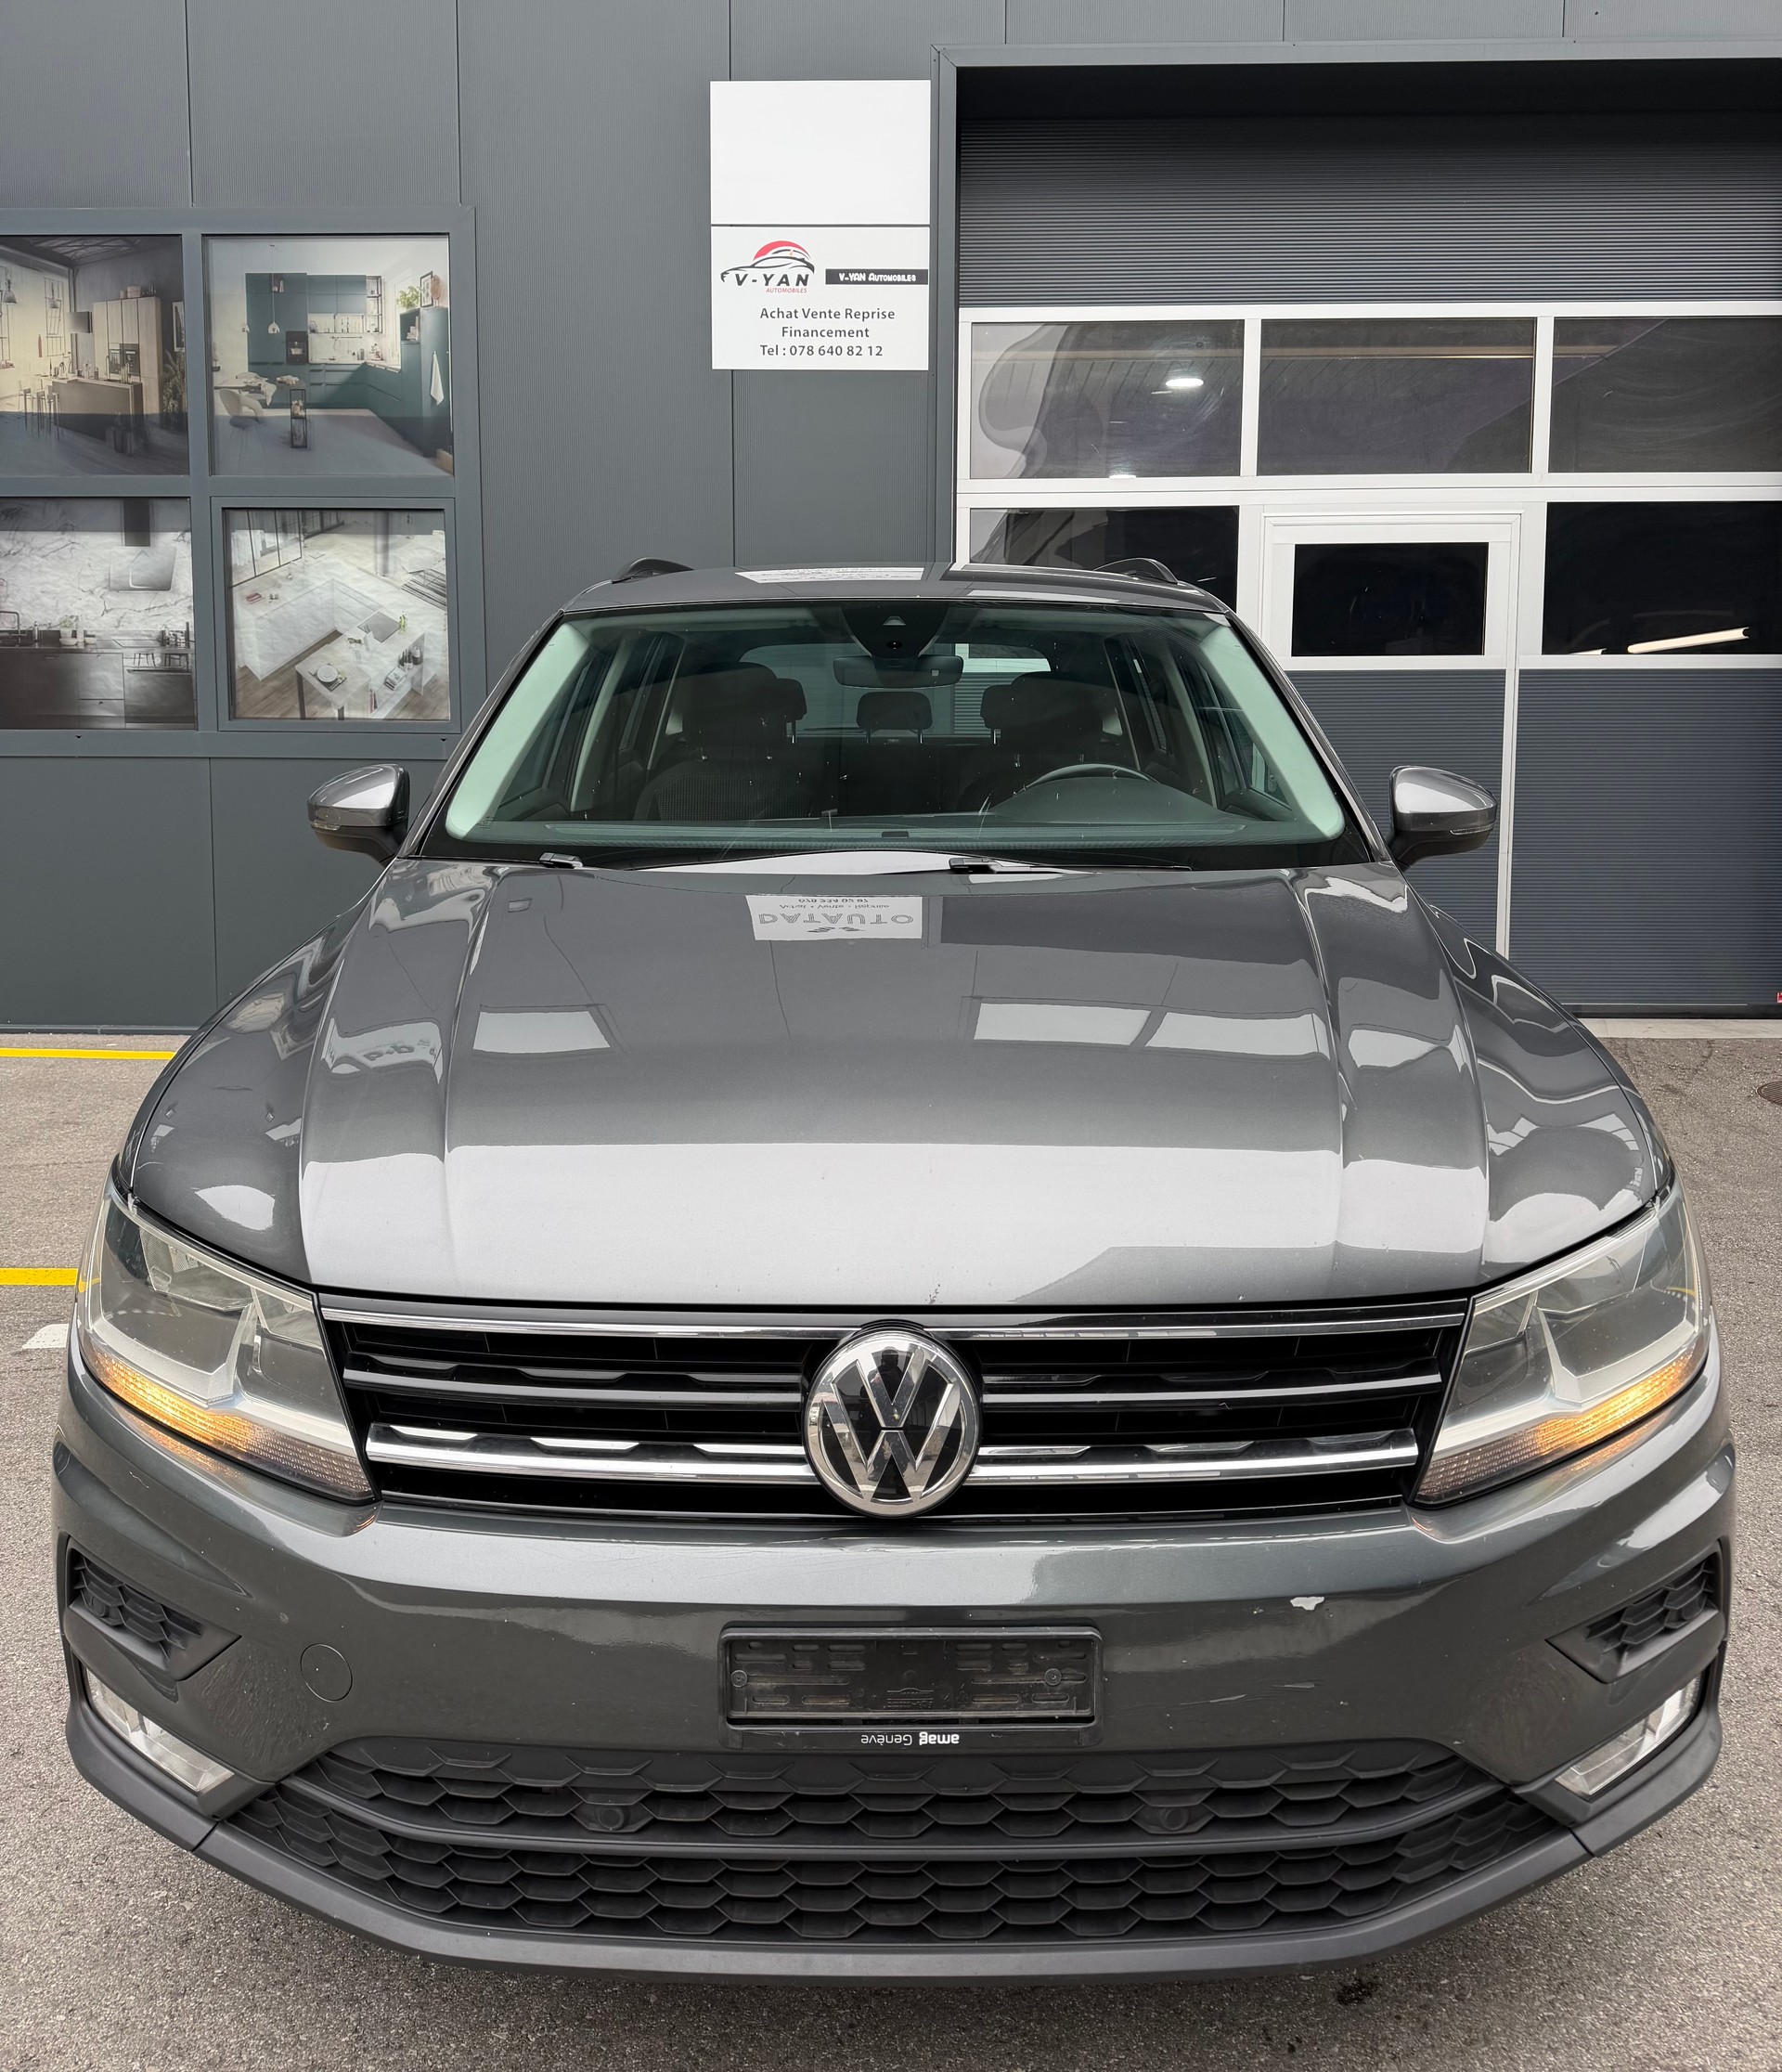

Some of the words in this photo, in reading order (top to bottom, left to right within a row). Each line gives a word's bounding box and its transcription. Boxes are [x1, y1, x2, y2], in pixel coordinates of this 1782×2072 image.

[838, 272, 866, 281] V-YAN
[760, 307, 799, 319] Achat
[802, 307, 841, 319] Vente
[845, 307, 896, 322] Reprise
[781, 326, 870, 338] Financement
[790, 345, 814, 356] 078
[818, 345, 843, 356] 640
[846, 345, 862, 356] 82
[868, 345, 884, 356] 12
[860, 1734, 912, 1746] Genève
[918, 1731, 960, 1745] amag
